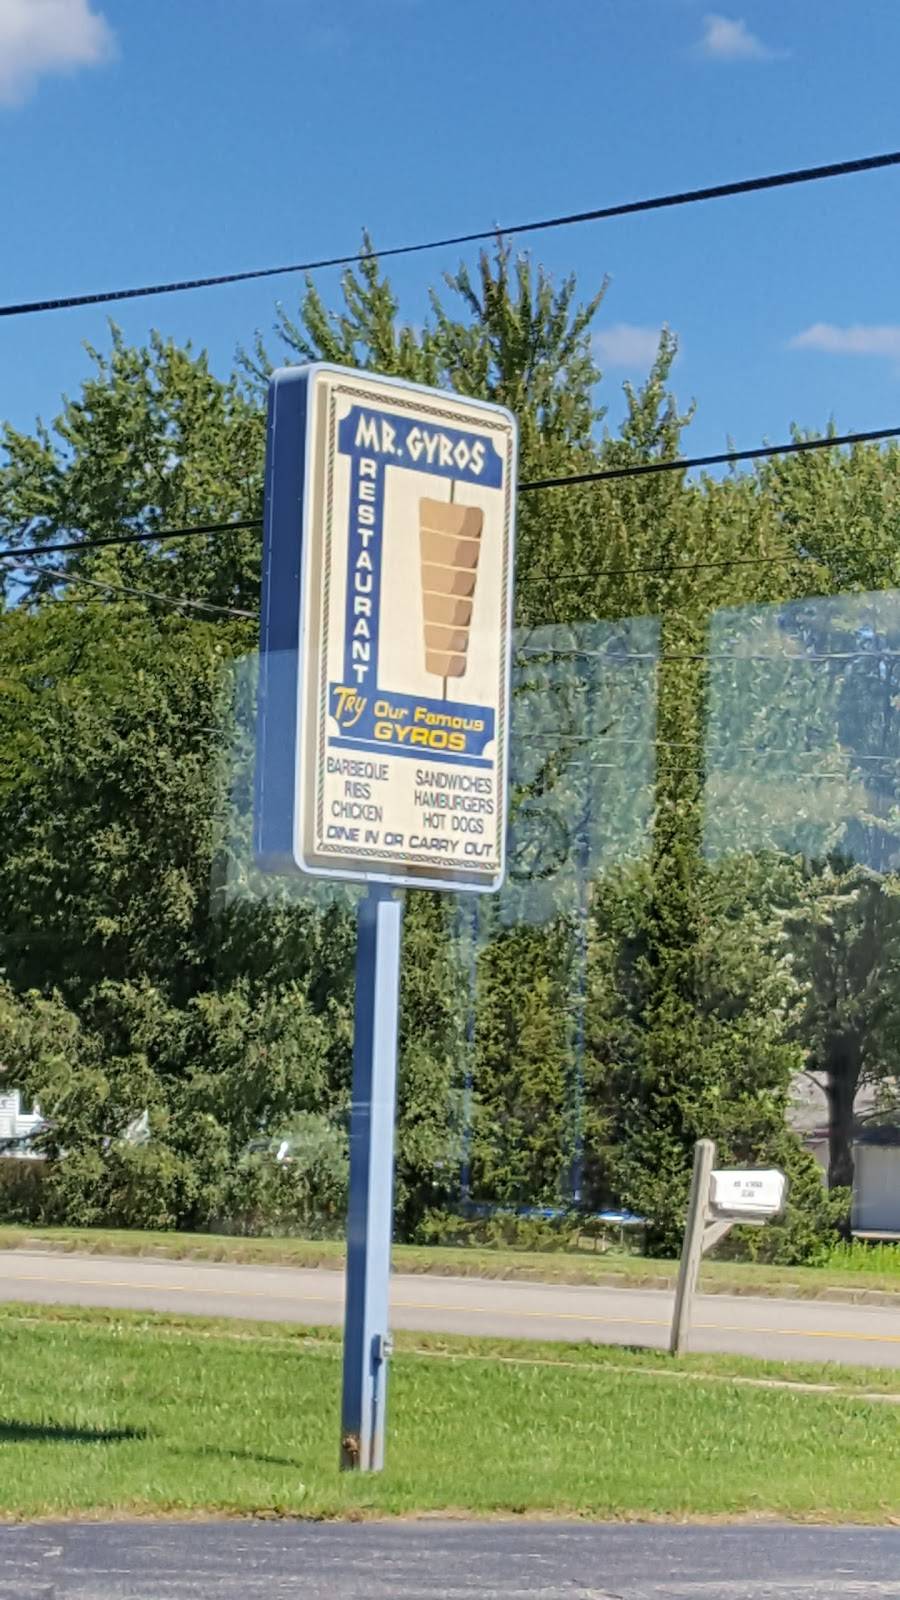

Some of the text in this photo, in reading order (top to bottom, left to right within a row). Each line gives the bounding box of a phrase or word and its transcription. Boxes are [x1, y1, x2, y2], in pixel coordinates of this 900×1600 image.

[355, 413, 486, 476] MR. GYROS
[352, 457, 377, 684] RESTAURANT
[374, 700, 409, 721] Our
[414, 706, 485, 732] Famous
[374, 721, 467, 750] GYROS
[327, 756, 389, 781] BARBEQUE
[415, 769, 492, 795] SANDWICHES
[331, 800, 383, 823] CHICKEN
[414, 790, 494, 815] HAMBURGERS
[423, 812, 484, 834] HOT DOGS
[327, 825, 494, 857] DINE IN OR CARRY OUT
